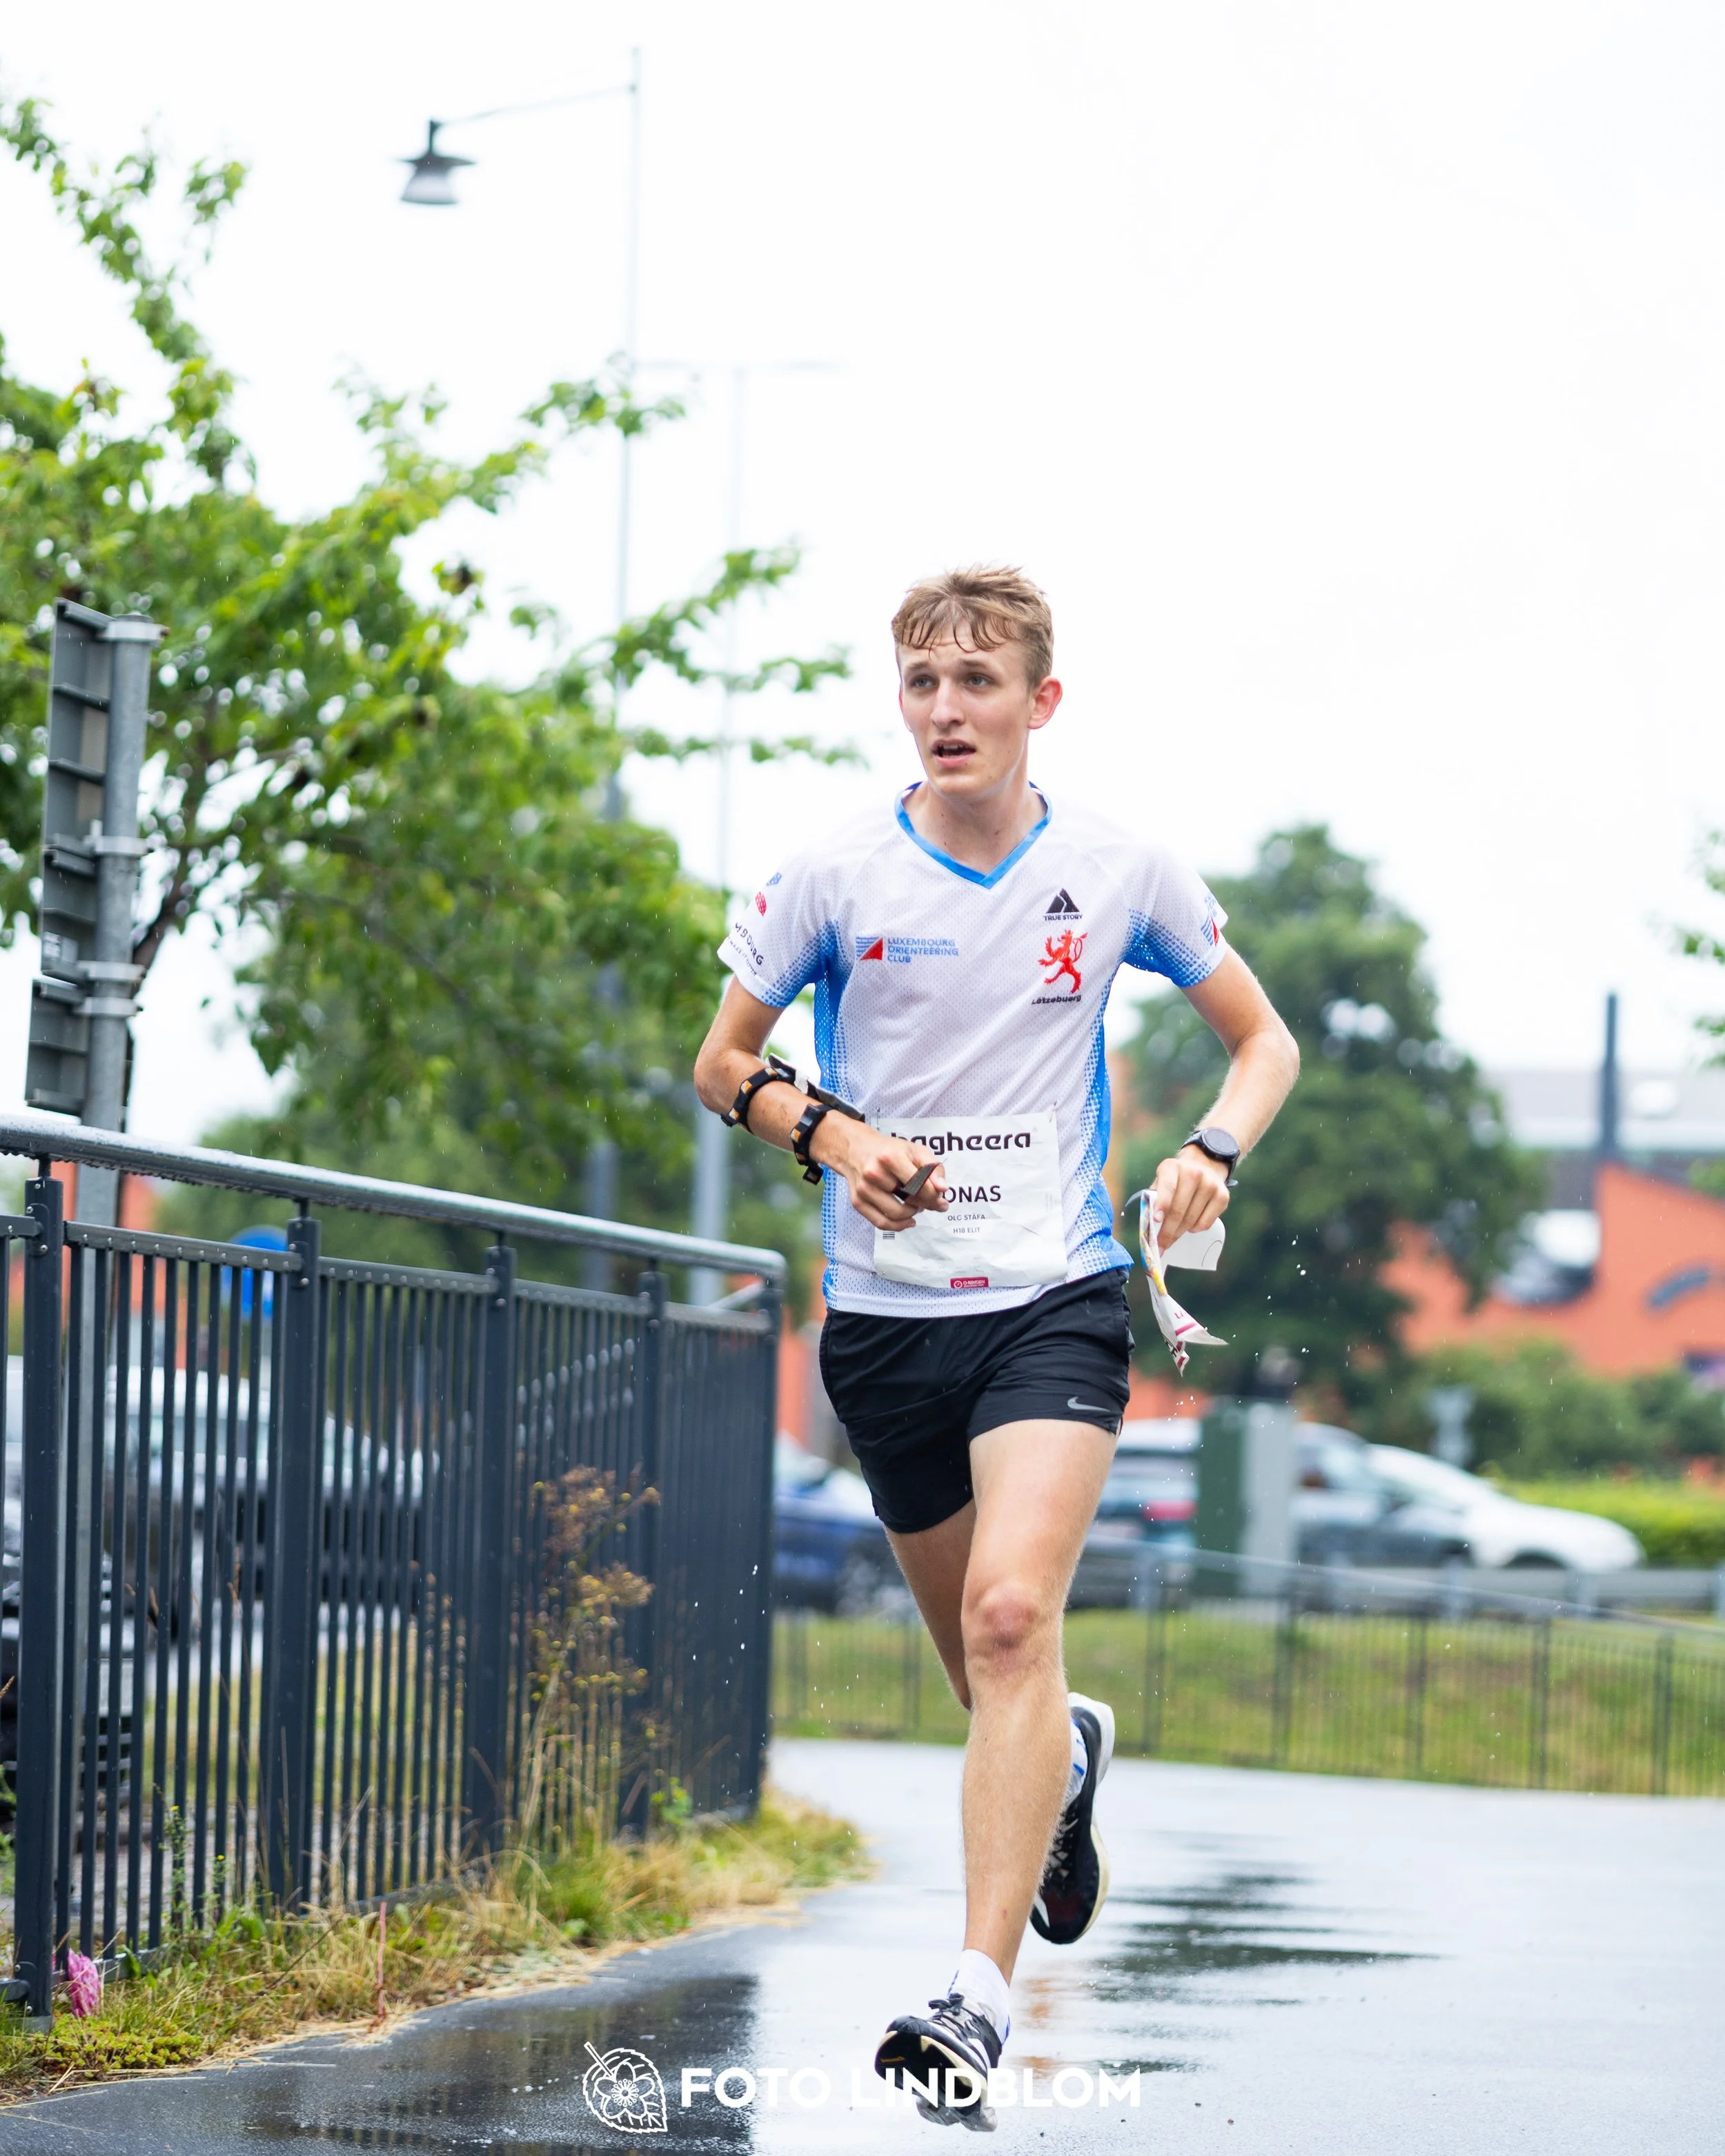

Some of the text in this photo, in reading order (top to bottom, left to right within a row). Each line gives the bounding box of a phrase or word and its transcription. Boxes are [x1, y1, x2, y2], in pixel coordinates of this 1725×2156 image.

[887, 937, 956, 947] LUXEMBOURG
[887, 946, 959, 956] ORIENTEERING
[887, 955, 911, 963] CLUB
[891, 1131, 1031, 1155] agheera
